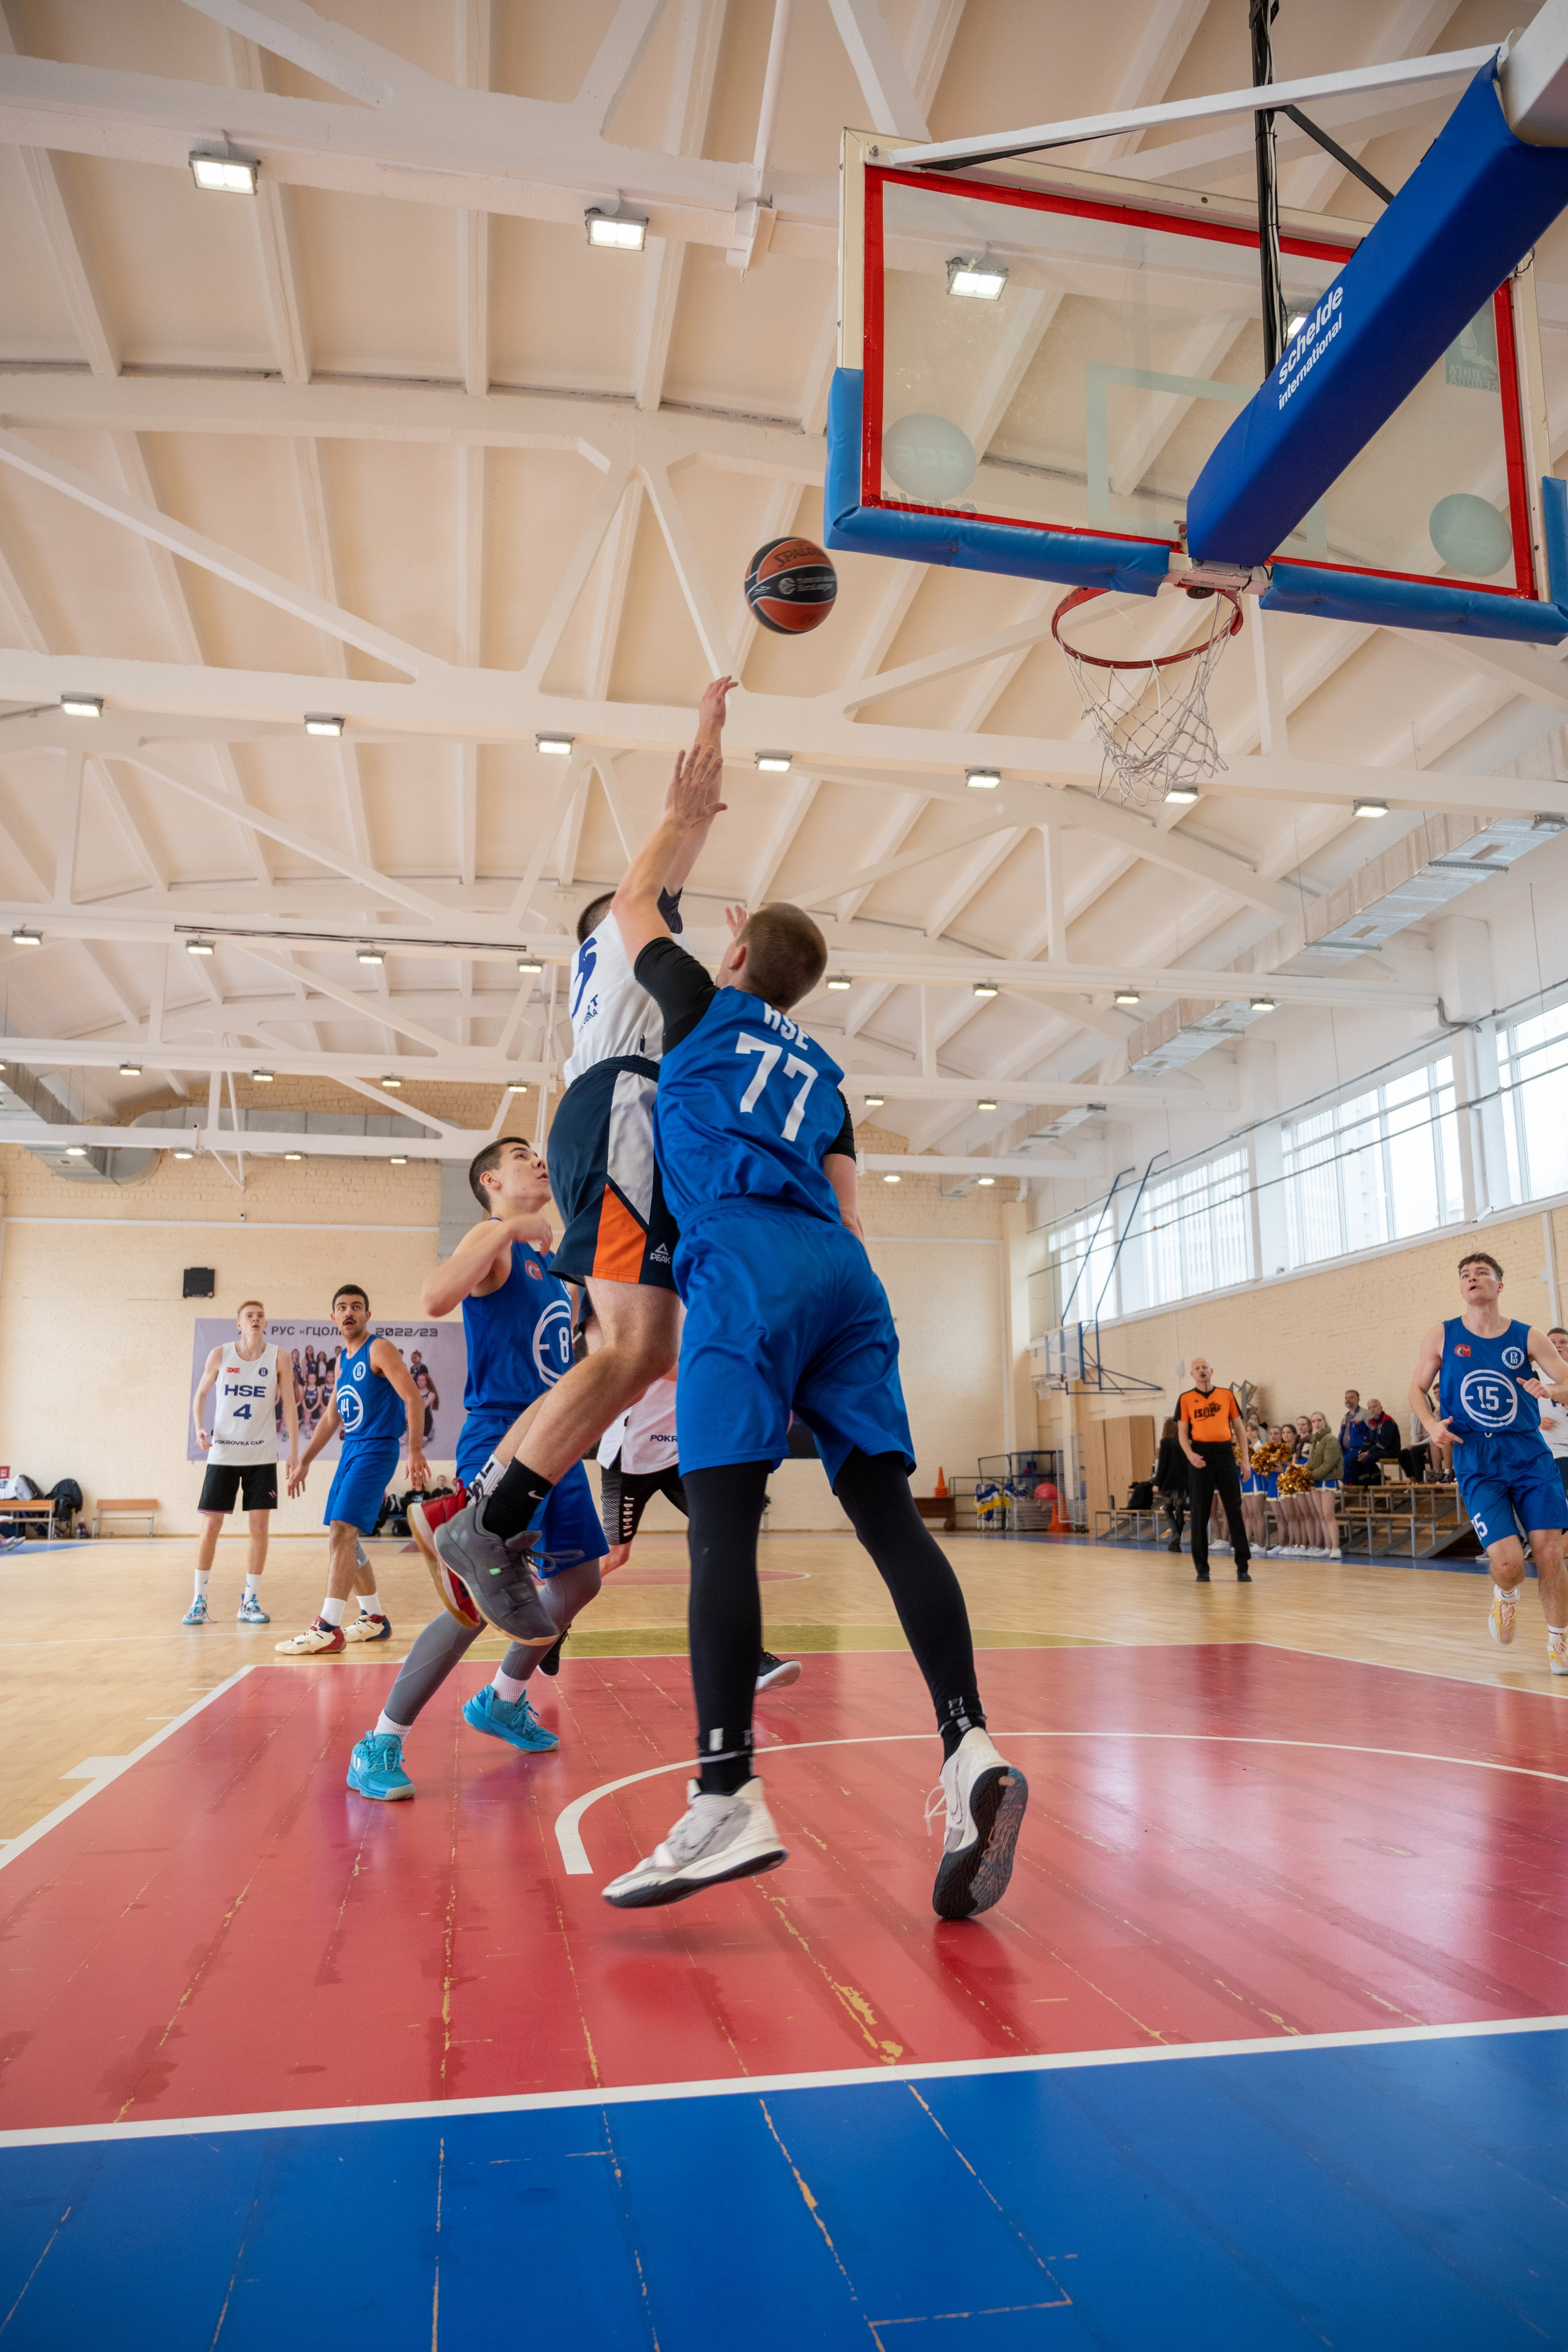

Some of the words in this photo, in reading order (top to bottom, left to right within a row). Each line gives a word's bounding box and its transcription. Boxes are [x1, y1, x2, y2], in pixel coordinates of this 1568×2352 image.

[1279, 287, 1343, 385] schelde
[1279, 312, 1342, 411] international
[735, 1031, 818, 1142] 77
[649, 1252, 672, 1264] PEAK
[271, 1326, 295, 1335] РУС
[375, 1327, 439, 1337] 2022/23
[559, 1327, 570, 1363] 8
[224, 1384, 266, 1398] HSE
[1477, 1385, 1499, 1411] 15
[233, 1403, 252, 1420] 4
[341, 1398, 350, 1418] 14
